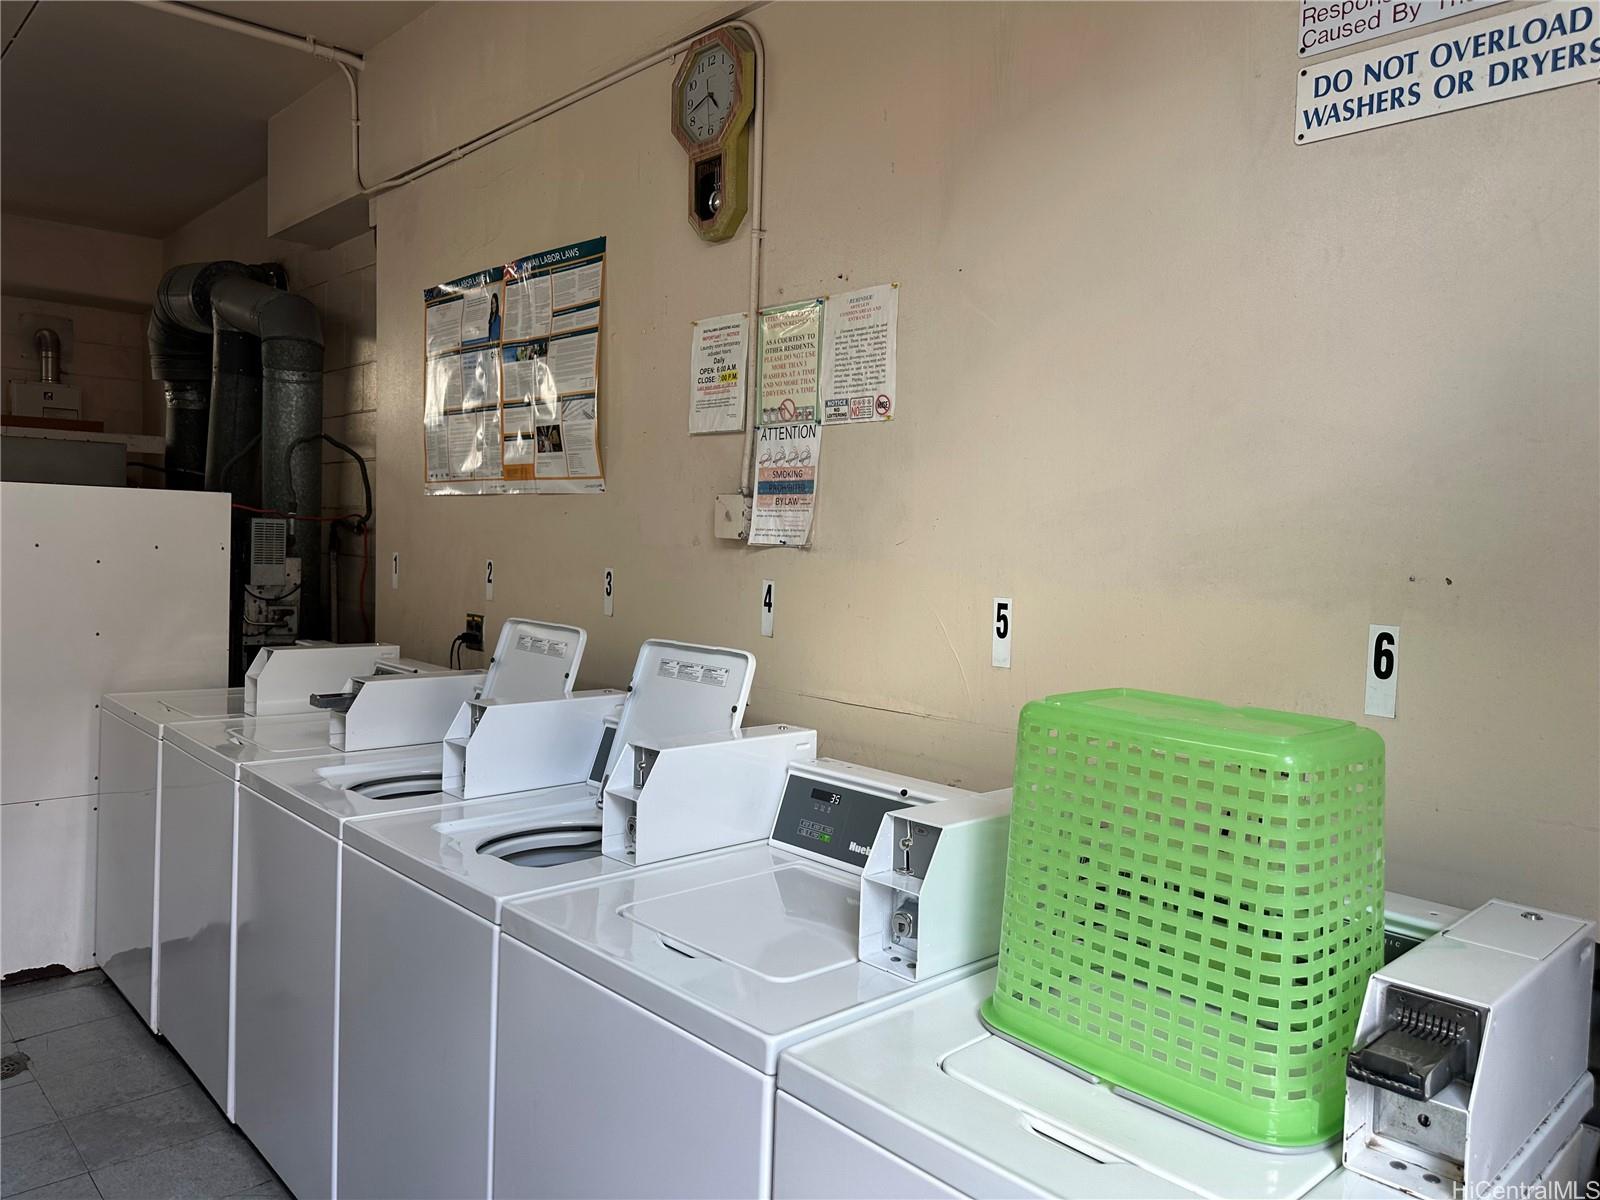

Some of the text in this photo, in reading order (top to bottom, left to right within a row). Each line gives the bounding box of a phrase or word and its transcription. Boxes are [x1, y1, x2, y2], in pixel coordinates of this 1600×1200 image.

[1302, 2, 1422, 49] Caused By
[1313, 6, 1593, 99] DO NOT OVERLOAD
[708, 55, 716, 67] 12
[698, 63, 705, 74] 11
[729, 64, 734, 75] 2
[689, 80, 697, 91] 10
[1303, 37, 1600, 130] WASHERS OR DRYERS
[688, 100, 693, 110] 9
[690, 116, 695, 126] 8
[698, 126, 704, 137] 7
[540, 253, 561, 265] LABOR
[561, 248, 580, 260] LAWS
[777, 334, 805, 344] COURTESY
[713, 357, 725, 365] Daily
[783, 352, 792, 361] DO
[802, 368, 816, 376] TIME
[760, 424, 817, 442] ATTENTION
[772, 469, 803, 479] SMOKING
[775, 497, 784, 506] BY
[784, 497, 799, 506] LAW
[393, 555, 398, 575] 1
[487, 561, 493, 584] 2
[606, 571, 612, 597] 3
[763, 583, 773, 613] 4
[995, 602, 1009, 639] 5
[1373, 631, 1396, 680] 6
[830, 793, 841, 805] 35
